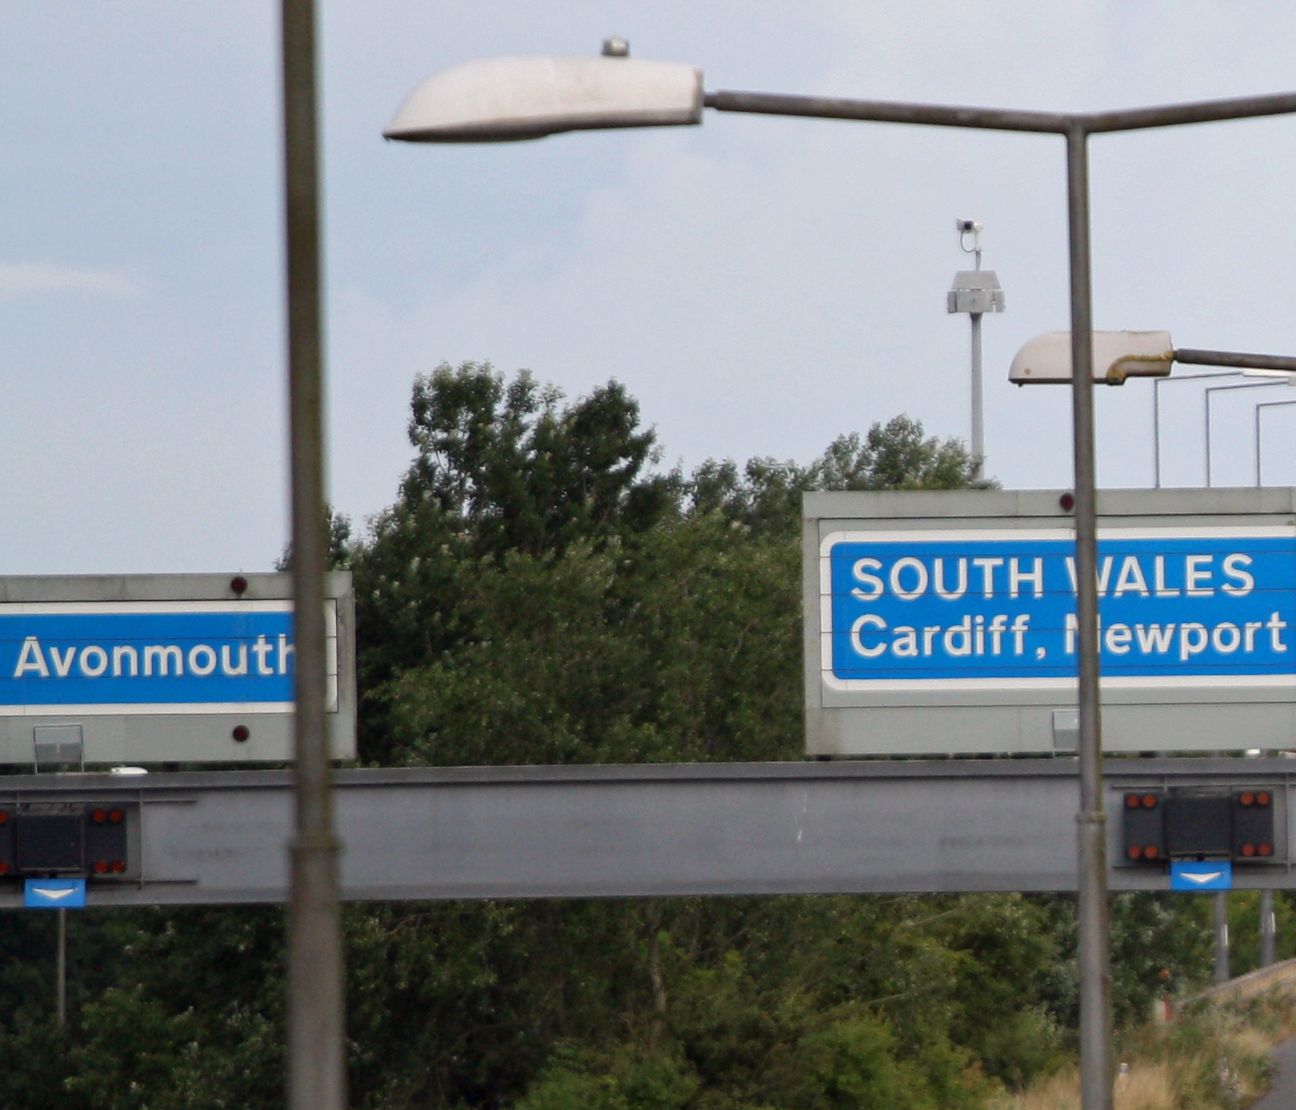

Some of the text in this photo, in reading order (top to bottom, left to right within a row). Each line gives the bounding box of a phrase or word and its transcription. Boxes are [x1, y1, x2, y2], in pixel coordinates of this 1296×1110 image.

[851, 553, 1255, 601] SOUTH WALES
[14, 633, 297, 678] Avonmouth
[851, 614, 1047, 660] Cardiff,
